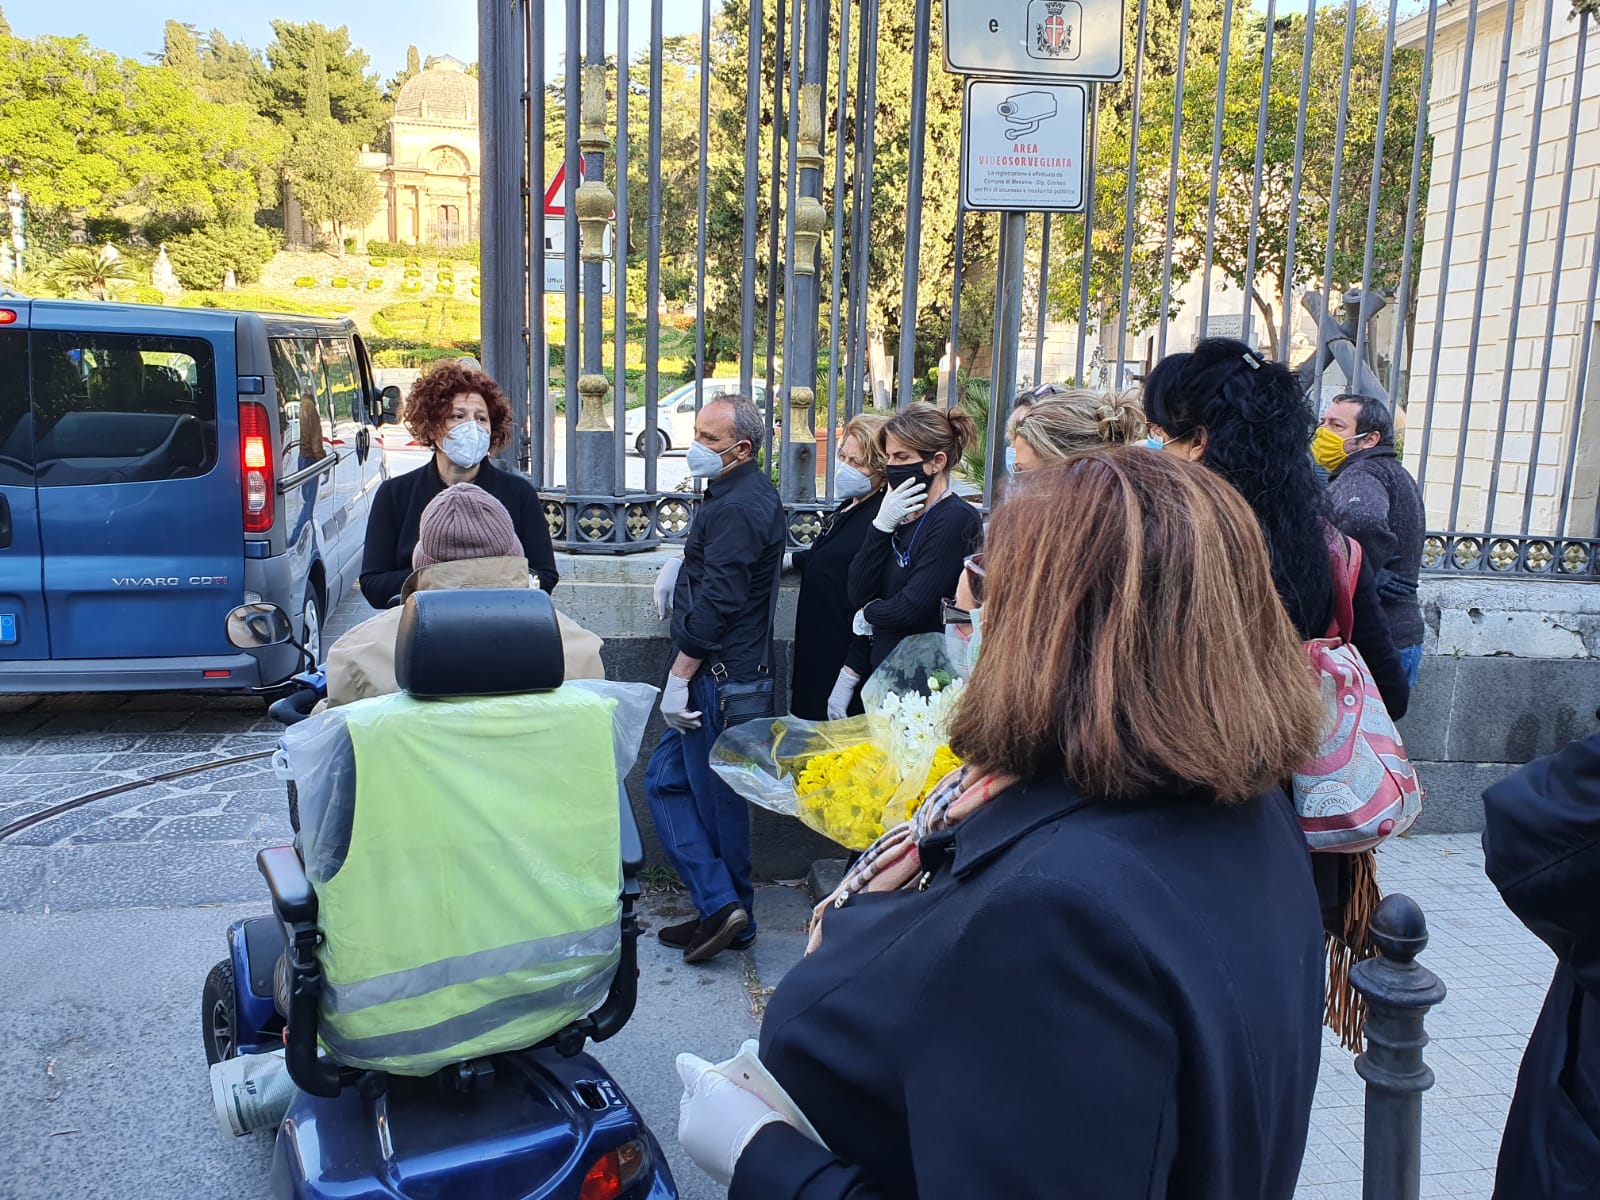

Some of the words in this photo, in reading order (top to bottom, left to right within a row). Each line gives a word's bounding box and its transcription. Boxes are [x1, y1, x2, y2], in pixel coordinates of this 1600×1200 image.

[988, 18, 999, 33] e
[1013, 143, 1038, 154] AREA
[979, 155, 1072, 168] VIDEOSORVEGLIATA
[111, 577, 180, 586] VIVARO
